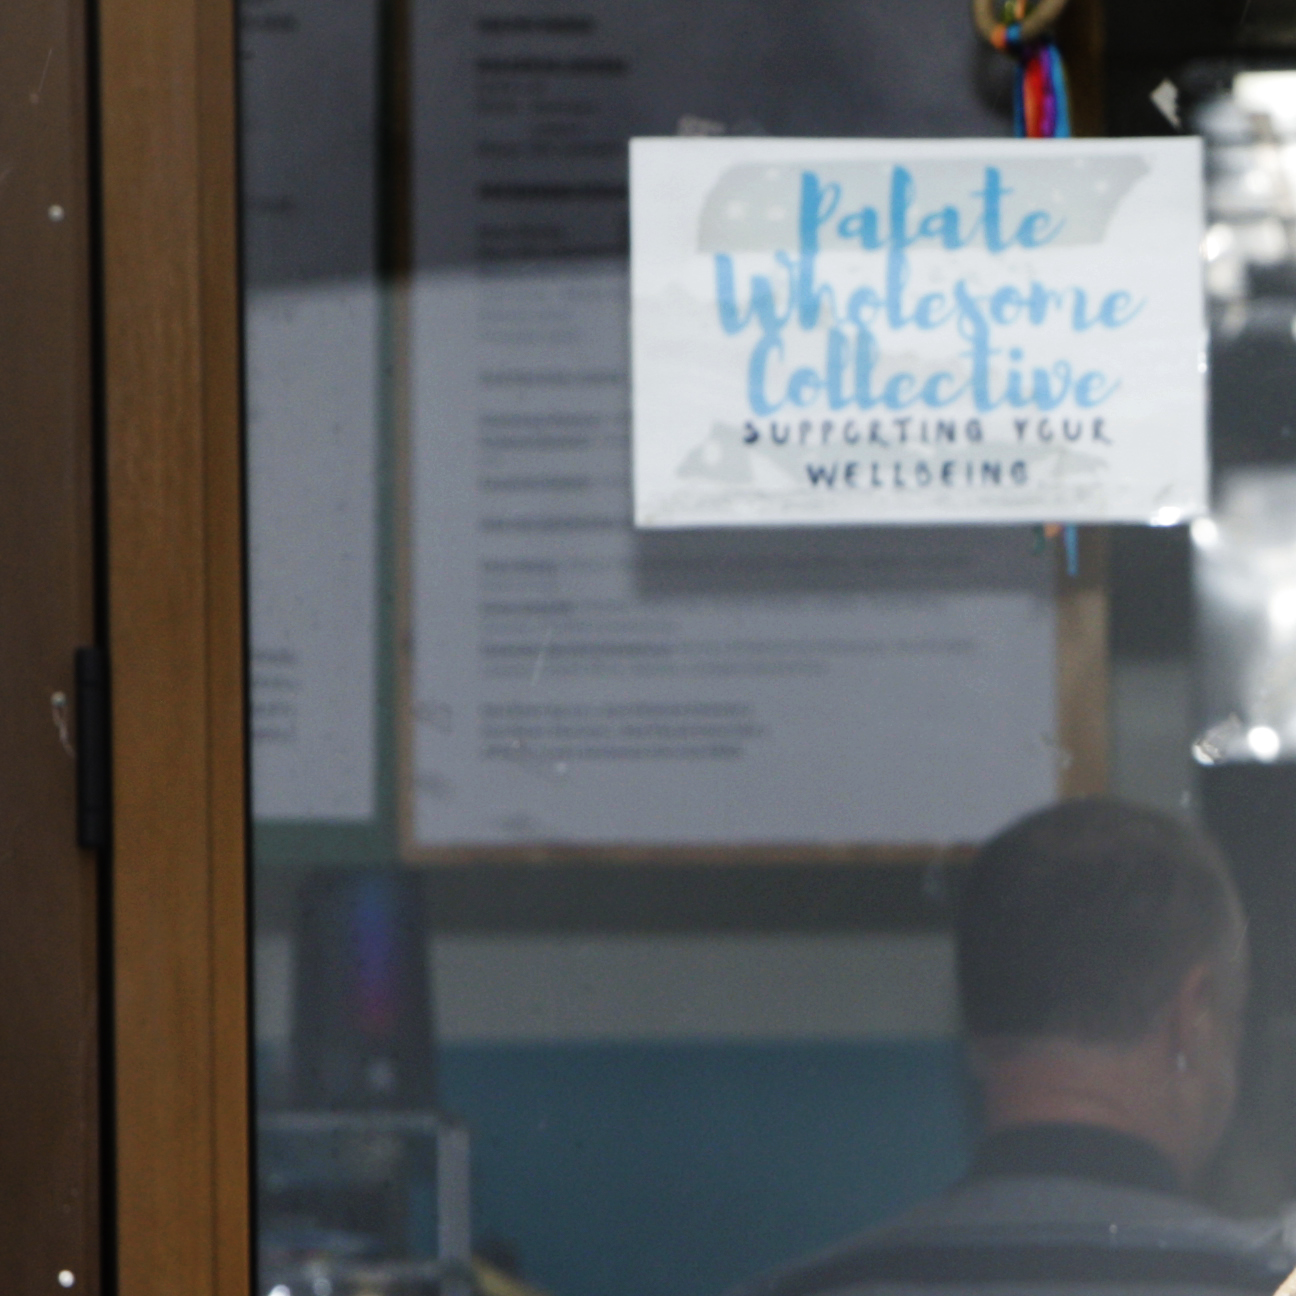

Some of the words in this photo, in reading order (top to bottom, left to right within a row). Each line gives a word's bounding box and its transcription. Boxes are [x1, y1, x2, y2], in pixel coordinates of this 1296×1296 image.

[800, 166, 1068, 254] Palate
[713, 249, 1147, 340] Wholesome
[747, 326, 1122, 417] Collective
[742, 417, 985, 447] SUPPORTING
[1013, 417, 1113, 446] YOUR
[806, 459, 1032, 489] WELLBEING
